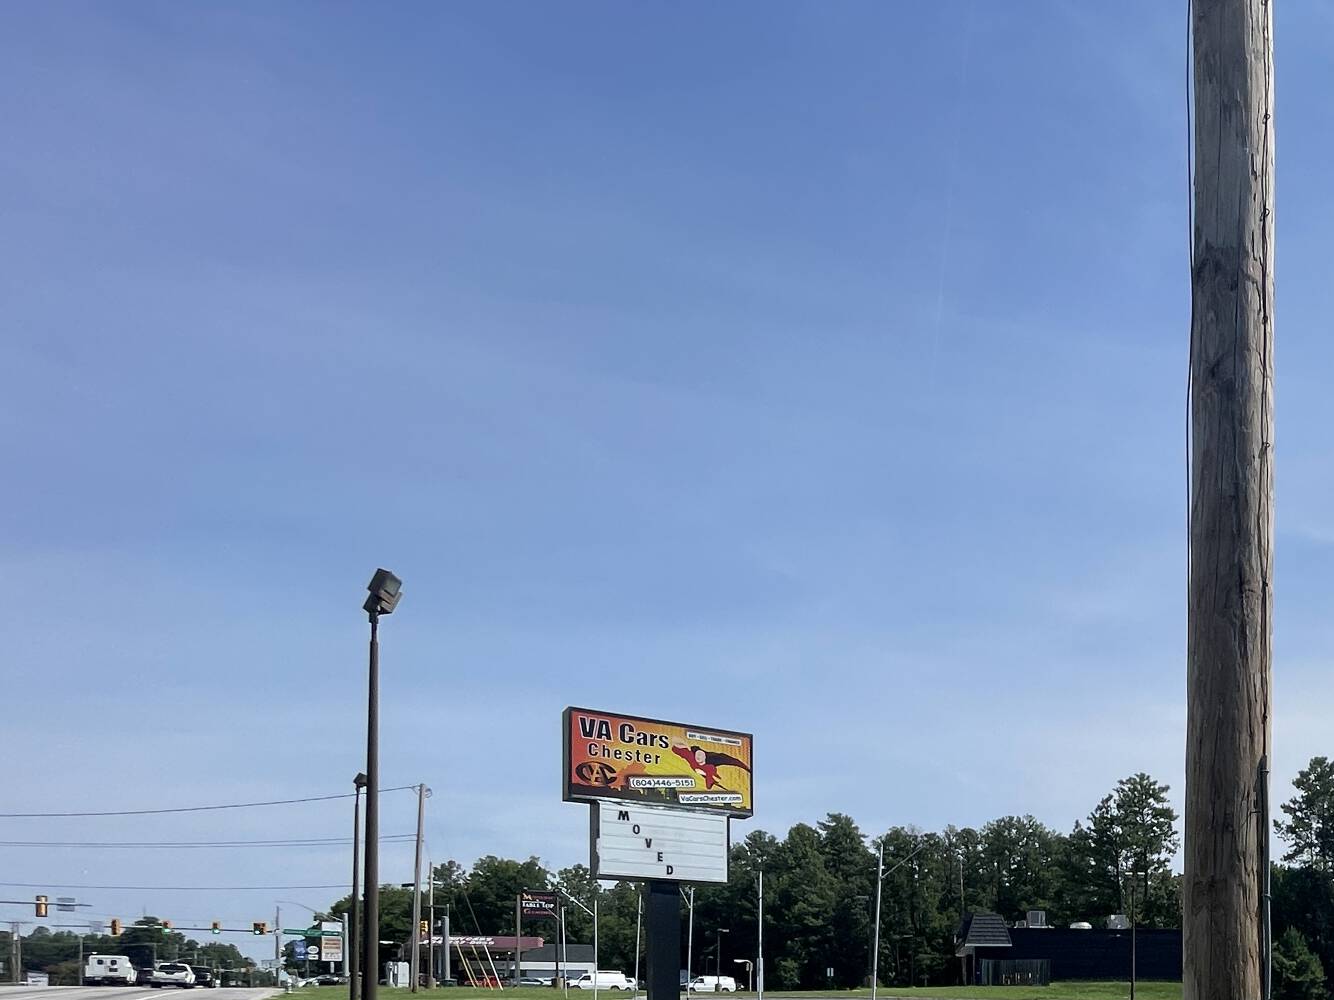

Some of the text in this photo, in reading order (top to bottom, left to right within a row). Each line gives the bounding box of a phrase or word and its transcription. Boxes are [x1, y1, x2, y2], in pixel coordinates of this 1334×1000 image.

[579, 716, 612, 741] VA
[619, 723, 670, 749] Cars
[588, 742, 660, 765] Chester
[631, 778, 694, 787] (804)446-5151
